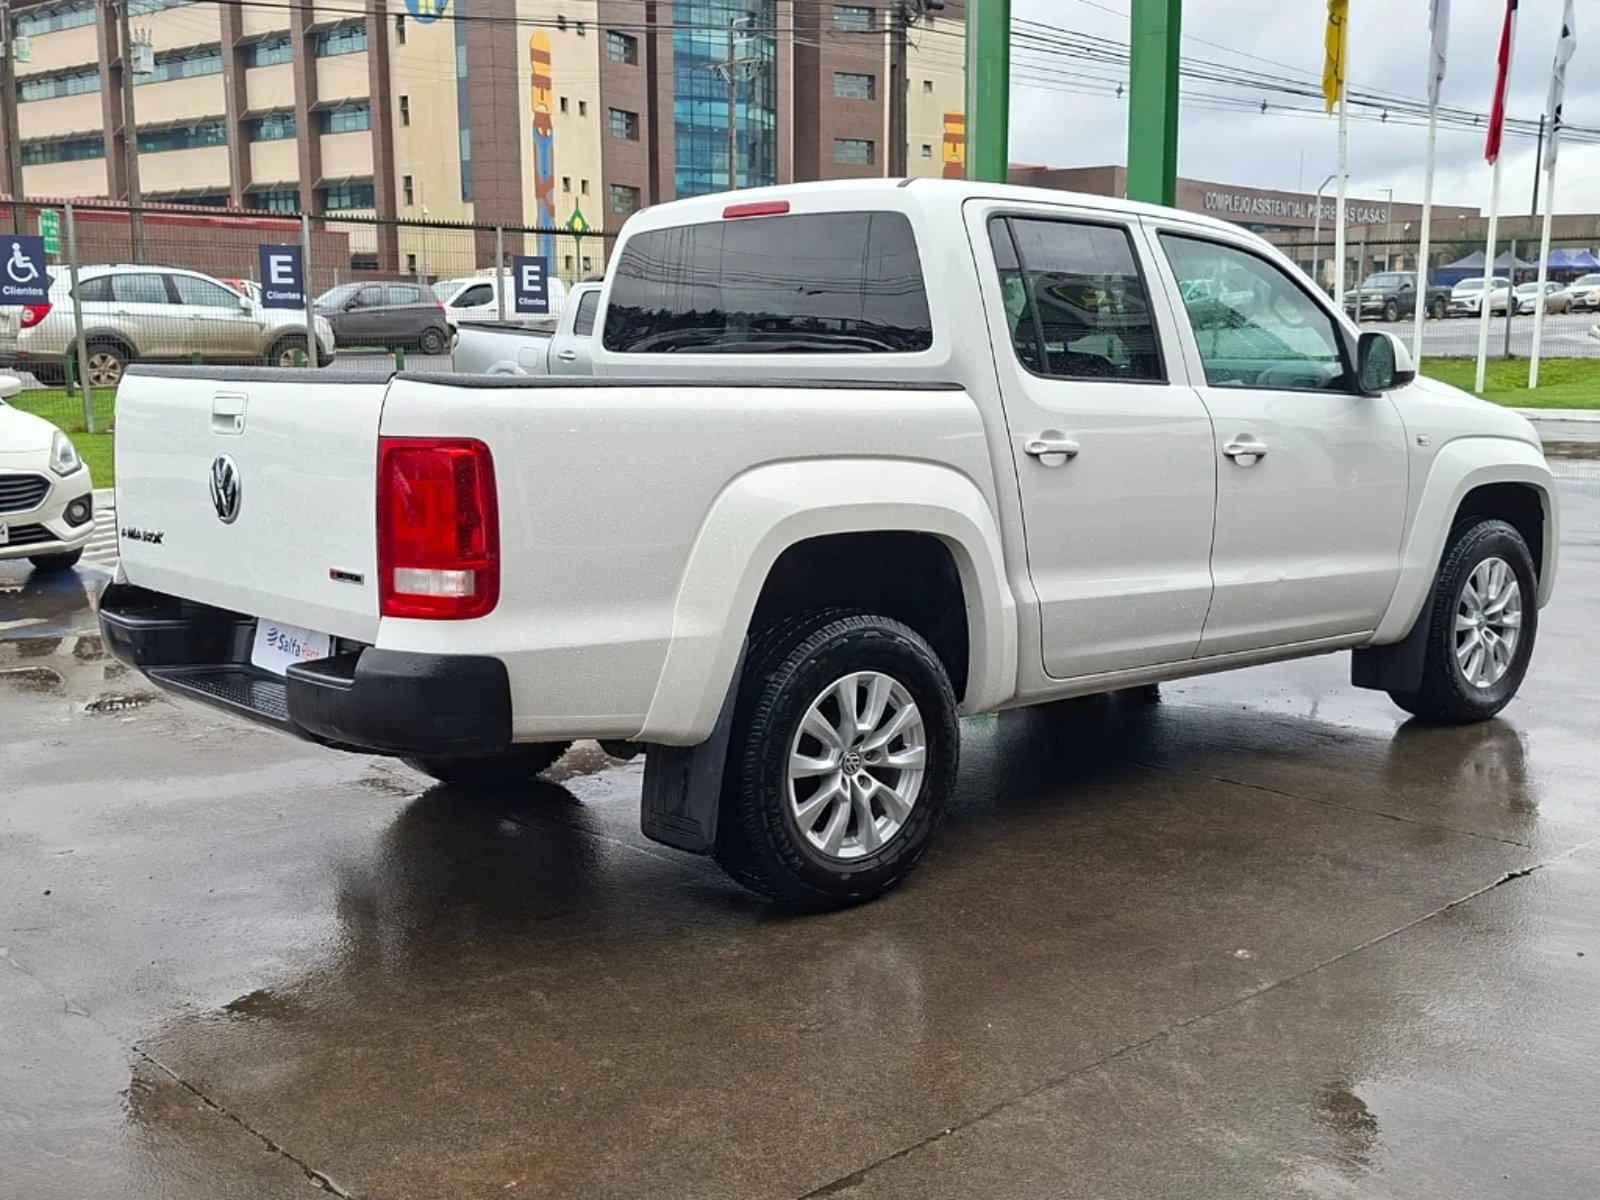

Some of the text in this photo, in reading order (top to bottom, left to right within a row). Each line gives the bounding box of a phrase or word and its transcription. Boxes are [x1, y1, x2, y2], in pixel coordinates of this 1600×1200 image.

[1205, 191, 1250, 212] COMPLEJO
[1357, 207, 1387, 223] CASAS
[269, 254, 295, 284] E
[522, 265, 542, 291] E
[2, 285, 44, 296] Clientes
[266, 290, 301, 300] Clientes
